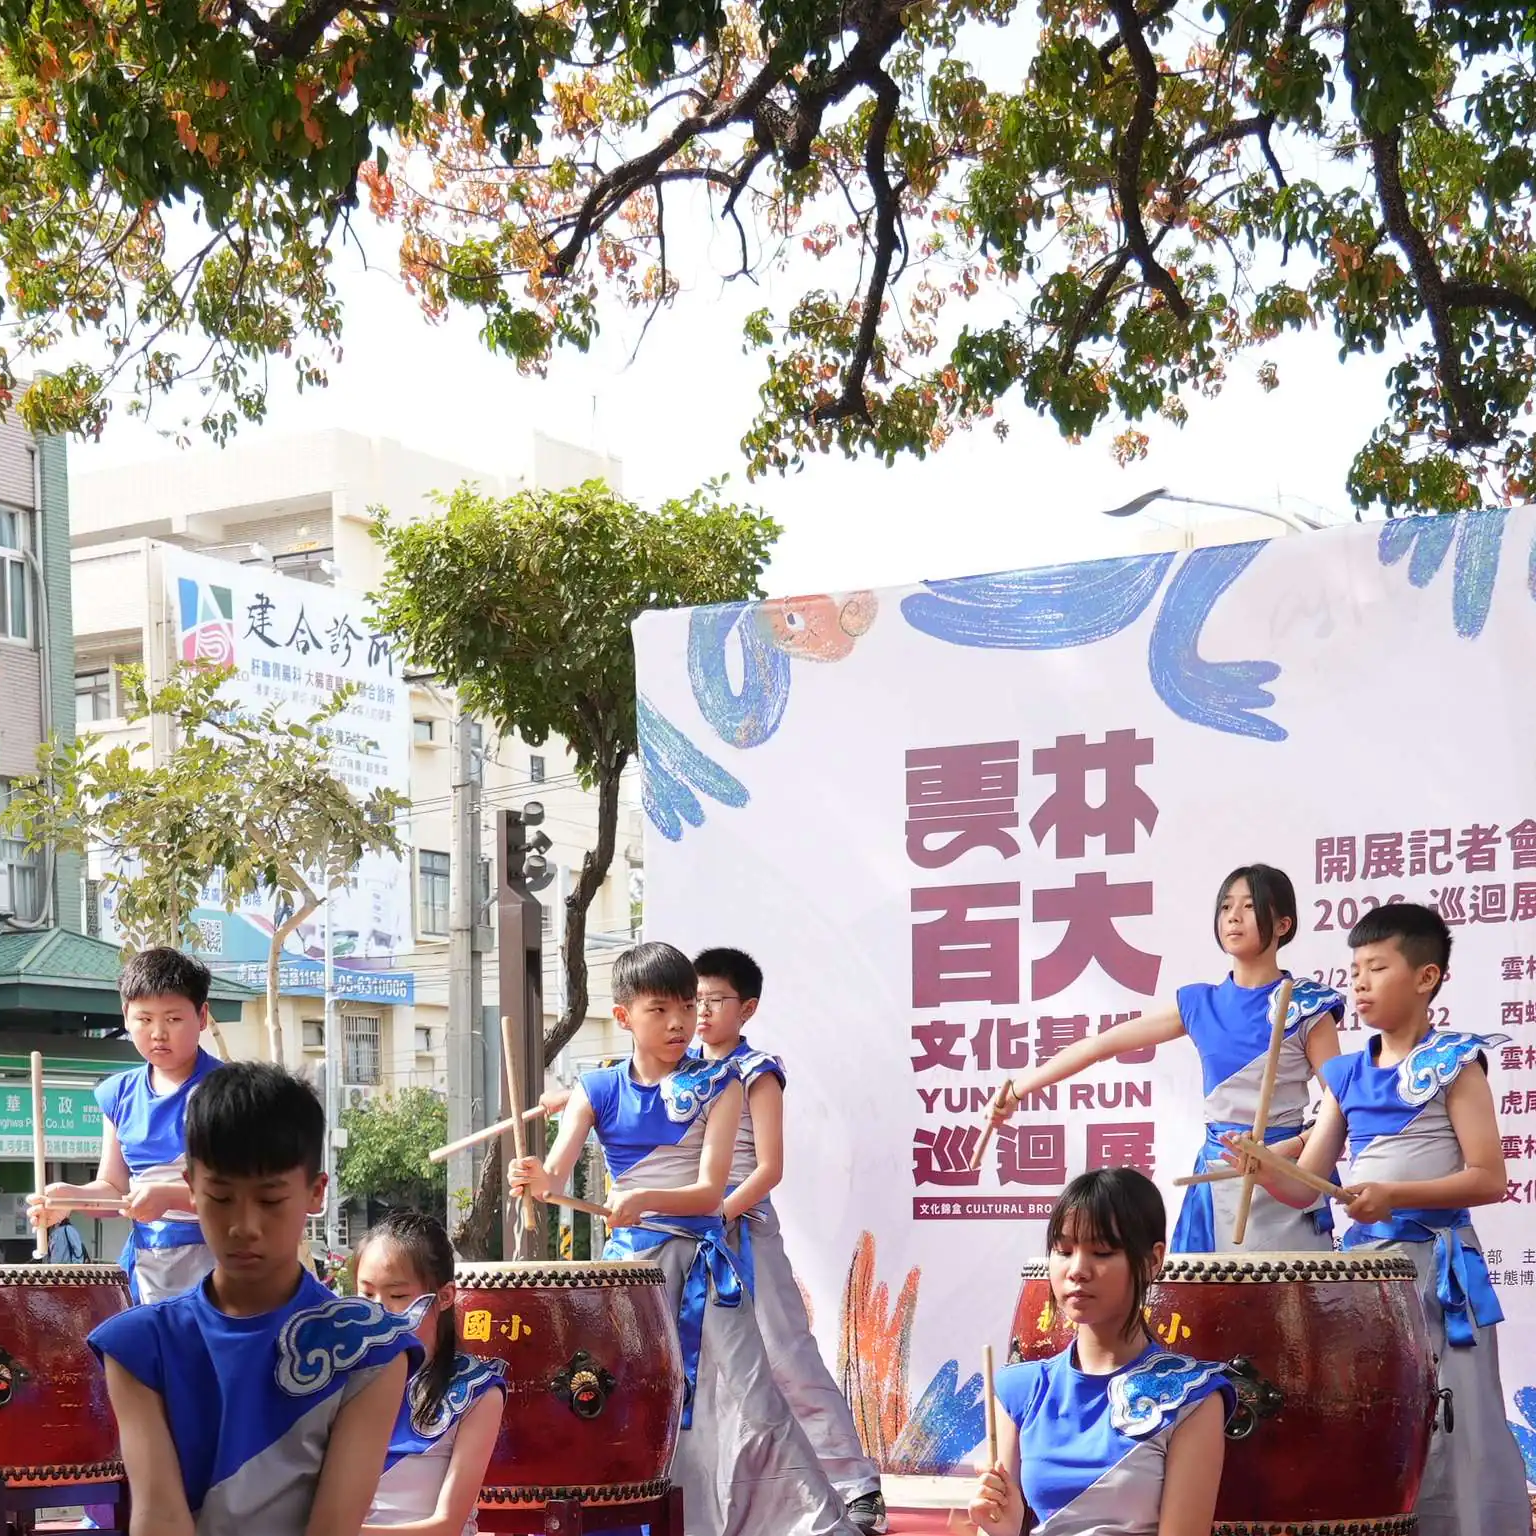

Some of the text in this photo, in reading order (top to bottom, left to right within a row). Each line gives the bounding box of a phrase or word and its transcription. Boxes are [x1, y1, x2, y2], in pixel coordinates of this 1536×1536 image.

[905, 728, 1159, 869] 雲林
[910, 872, 1162, 1009] 百大
[917, 1081, 1152, 1114] YUNIN RUN
[912, 1122, 1156, 1188] 巡迴展
[919, 1203, 962, 1215] 文化錦盒
[966, 1203, 1025, 1214] CULTURAL
